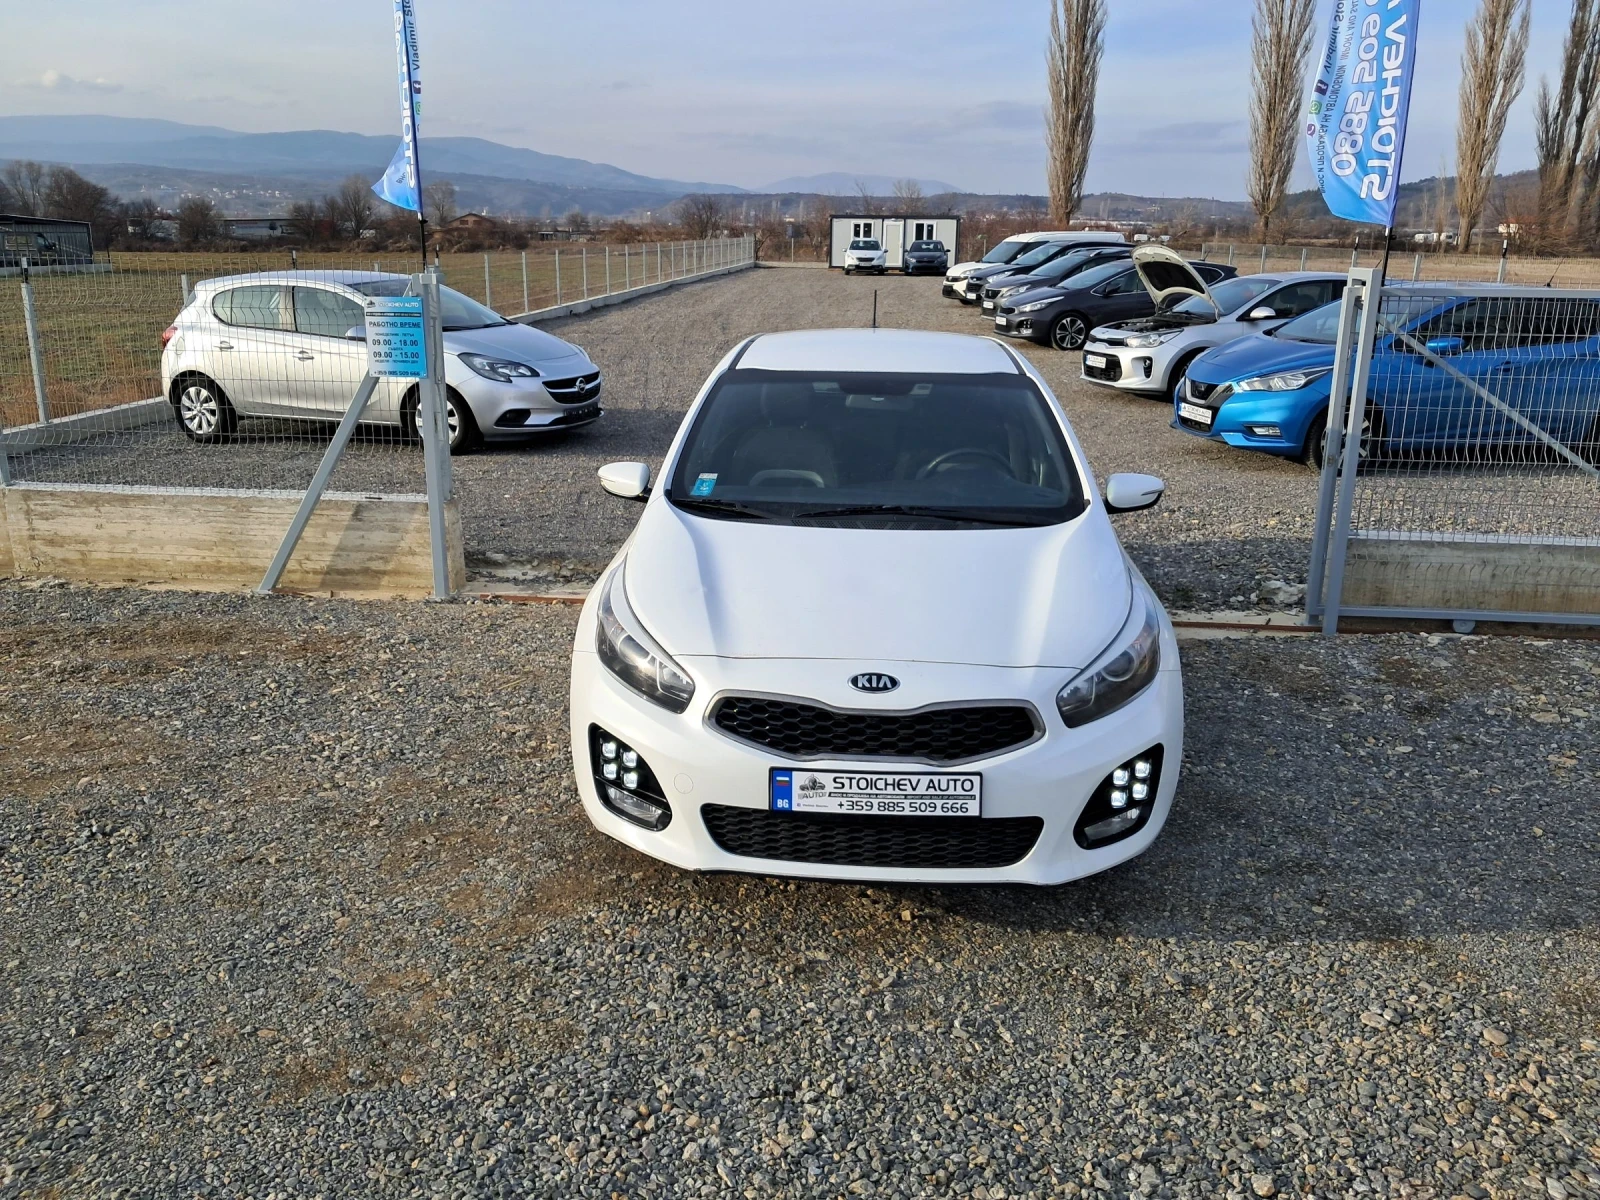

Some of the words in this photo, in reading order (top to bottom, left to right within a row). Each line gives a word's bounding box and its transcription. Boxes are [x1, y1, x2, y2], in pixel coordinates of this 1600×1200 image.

[407, 20, 420, 71] Vladimir
[399, 339, 419, 347] 18.00
[857, 675, 892, 688] KIA
[832, 776, 920, 792] STOICHEV
[925, 778, 974, 792] AUTO
[777, 799, 789, 808] BG
[837, 800, 873, 812] +359
[877, 801, 905, 812] 885
[908, 801, 937, 813] 509
[940, 802, 969, 813] 666
